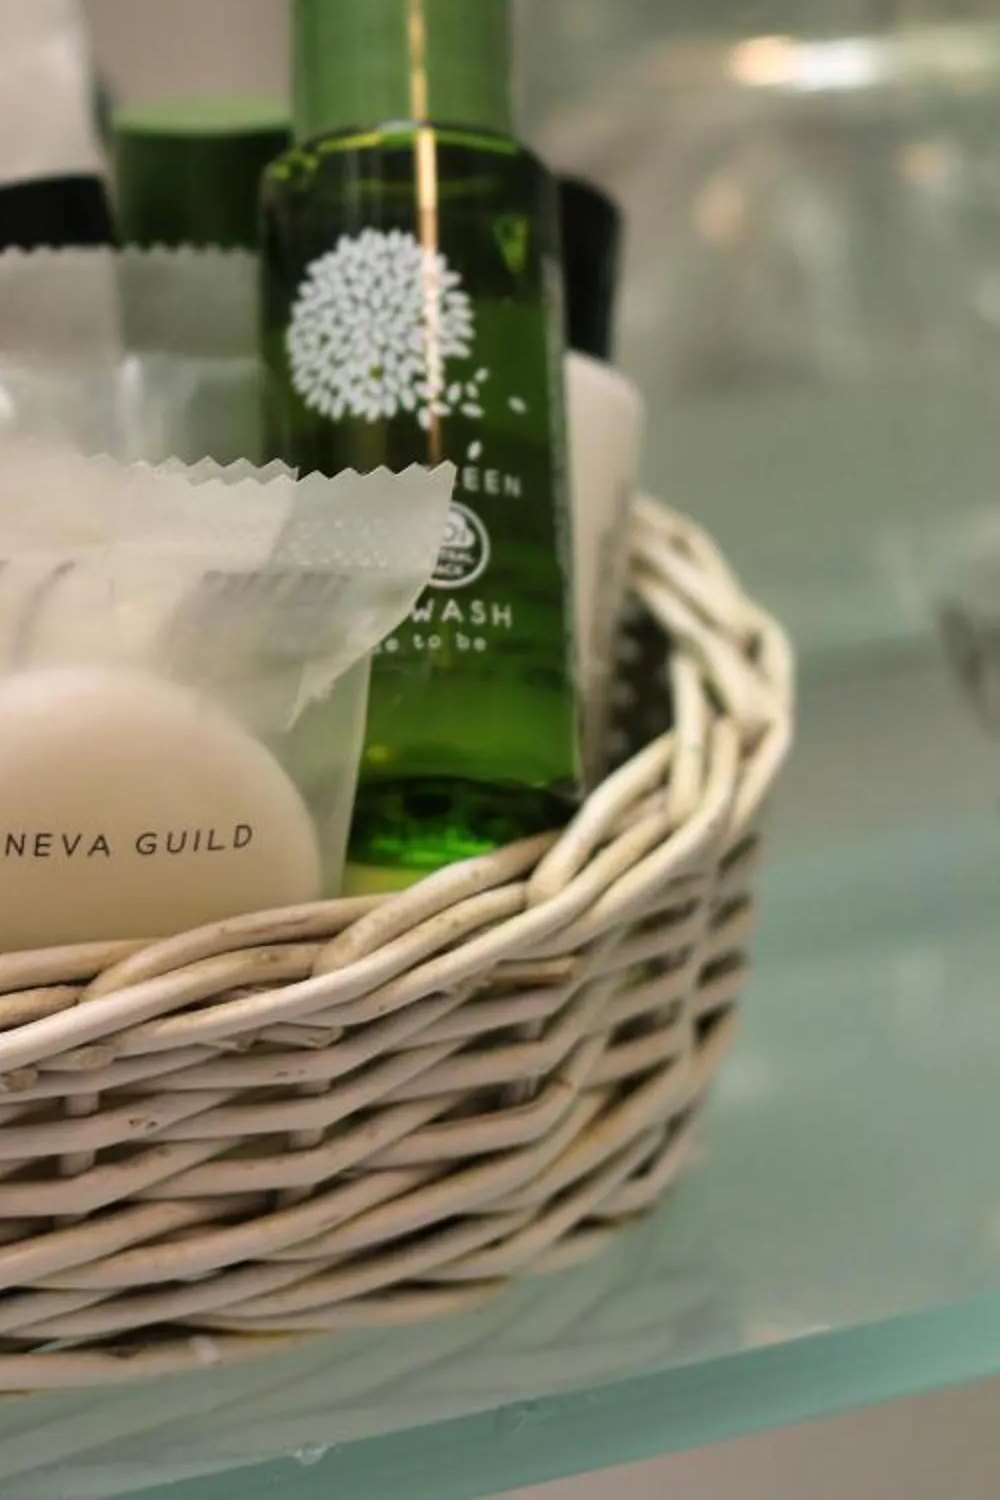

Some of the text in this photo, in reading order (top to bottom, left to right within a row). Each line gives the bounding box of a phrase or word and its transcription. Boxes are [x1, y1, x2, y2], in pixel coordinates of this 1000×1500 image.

[462, 466, 523, 498] EEN
[411, 598, 513, 629] WASH
[412, 633, 442, 651] to
[455, 631, 488, 652] be
[134, 824, 255, 856] GUILD
